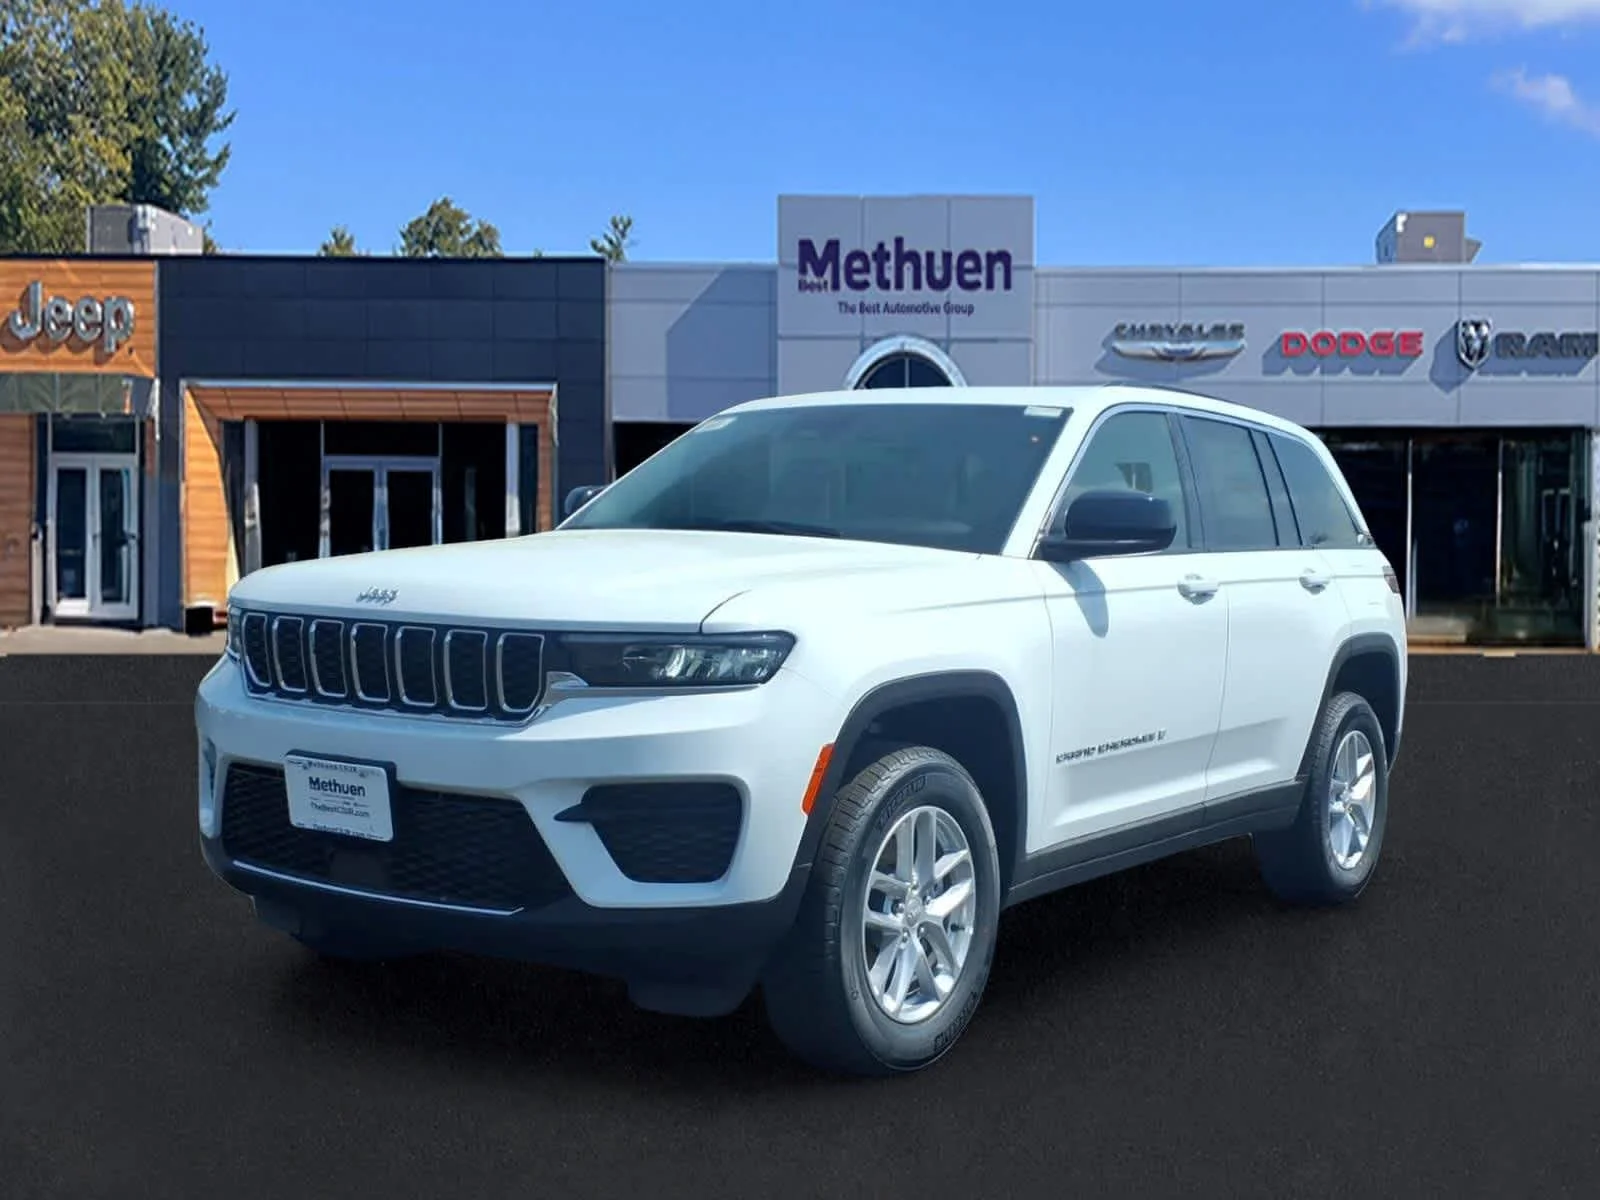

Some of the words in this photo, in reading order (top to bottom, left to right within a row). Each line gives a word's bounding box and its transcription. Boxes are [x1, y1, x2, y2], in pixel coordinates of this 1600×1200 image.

[798, 236, 1012, 291] Methuen
[9, 280, 136, 353] Jeep
[838, 302, 856, 314] The
[859, 302, 881, 314] Best
[883, 301, 941, 314] Automotive
[943, 302, 974, 316] Group
[1281, 331, 1424, 357] DODGE
[1494, 332, 1599, 358] RAM
[308, 776, 366, 797] Methuen
